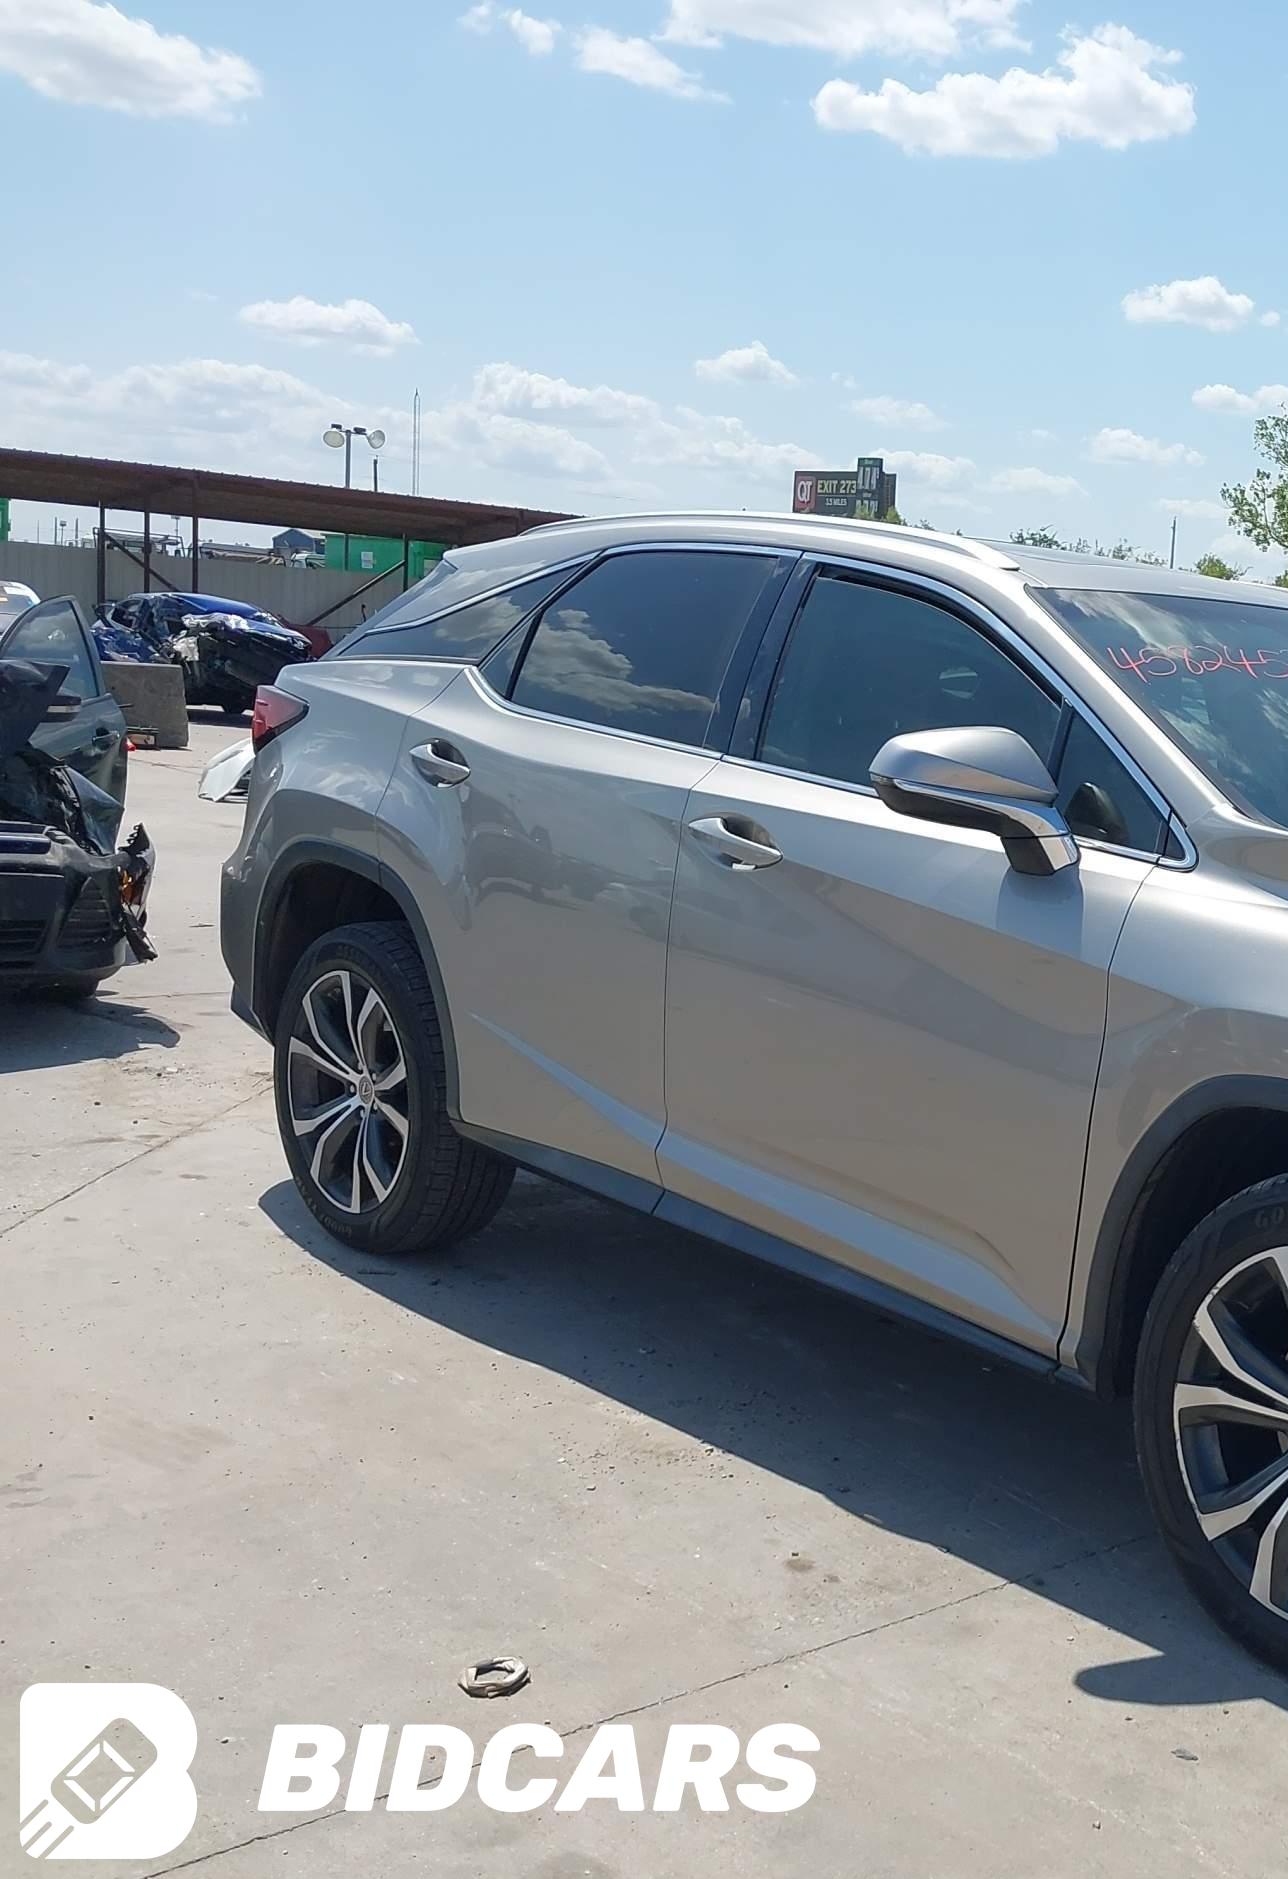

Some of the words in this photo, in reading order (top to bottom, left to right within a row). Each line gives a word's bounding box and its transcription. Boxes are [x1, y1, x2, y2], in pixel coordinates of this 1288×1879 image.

[797, 481, 812, 504] QT
[817, 480, 838, 493] EXIT
[840, 480, 856, 493] 273
[833, 498, 847, 506] MILES
